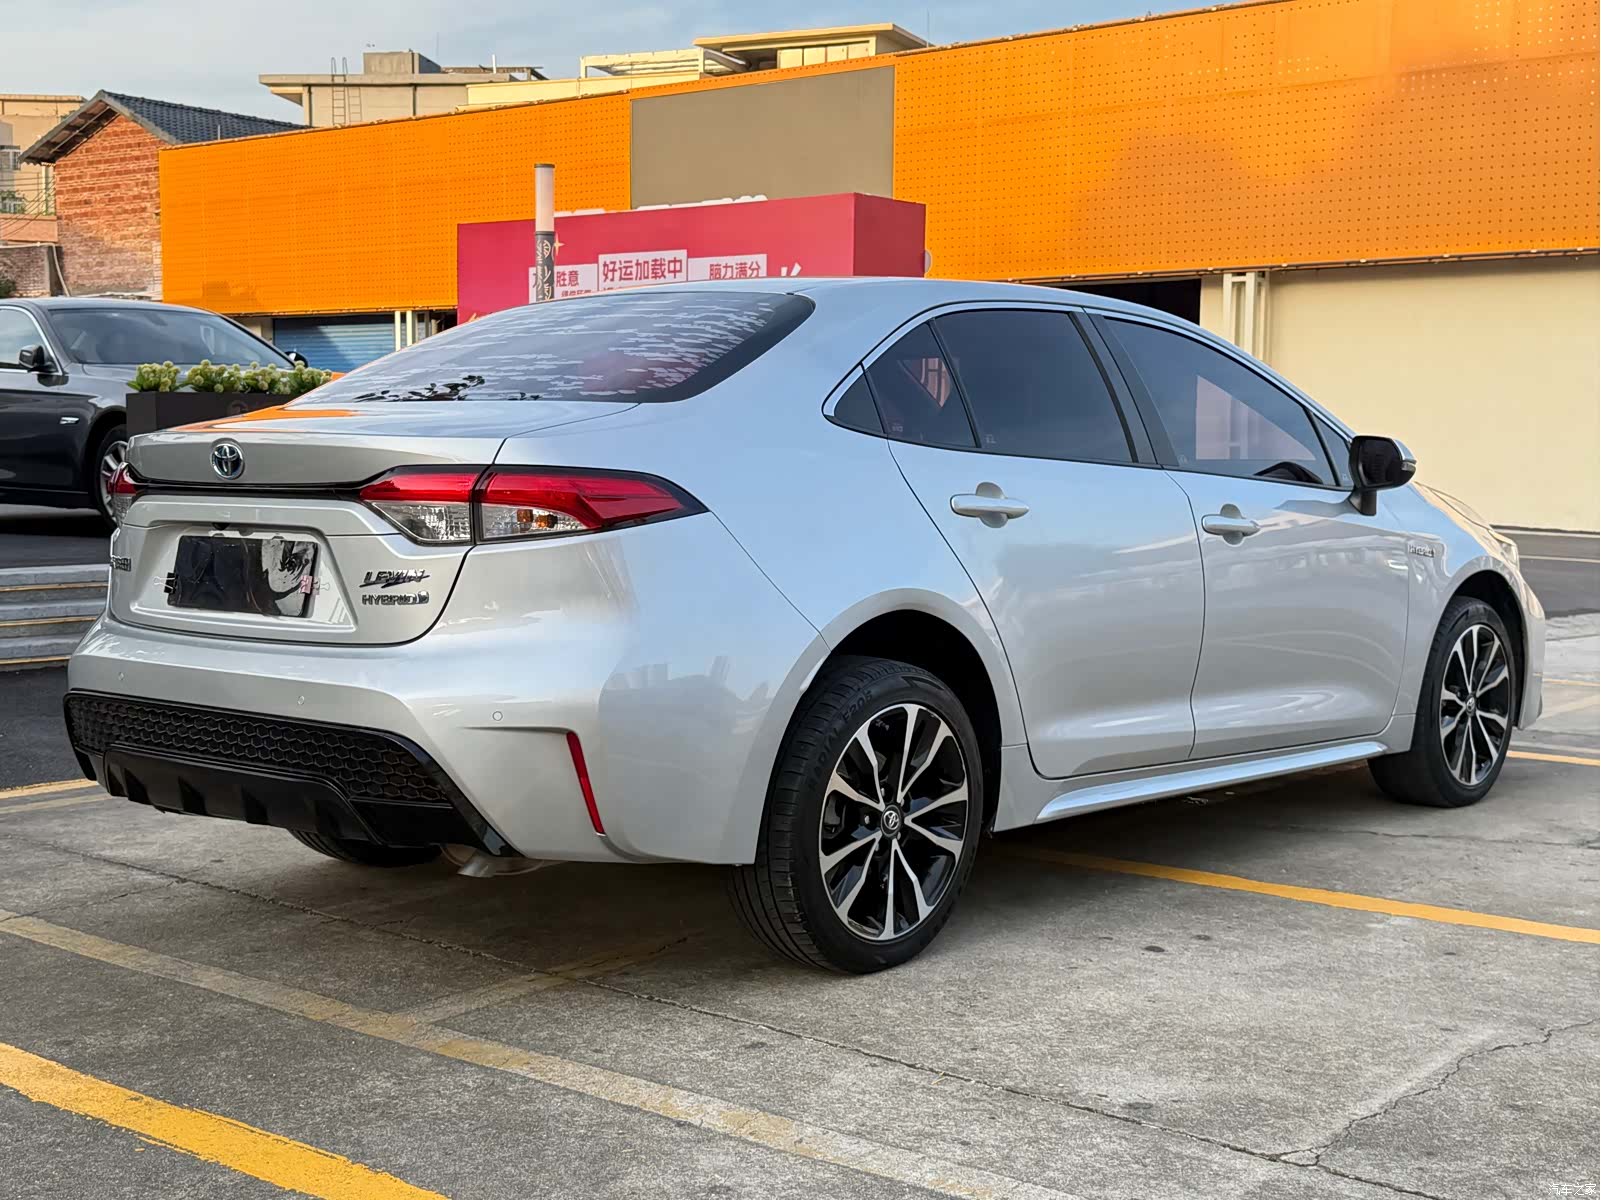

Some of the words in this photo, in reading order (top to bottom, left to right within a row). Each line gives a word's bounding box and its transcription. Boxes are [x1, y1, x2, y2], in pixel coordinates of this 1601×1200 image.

[602, 257, 683, 283] 好运加载中
[709, 261, 760, 280] 脑力满分
